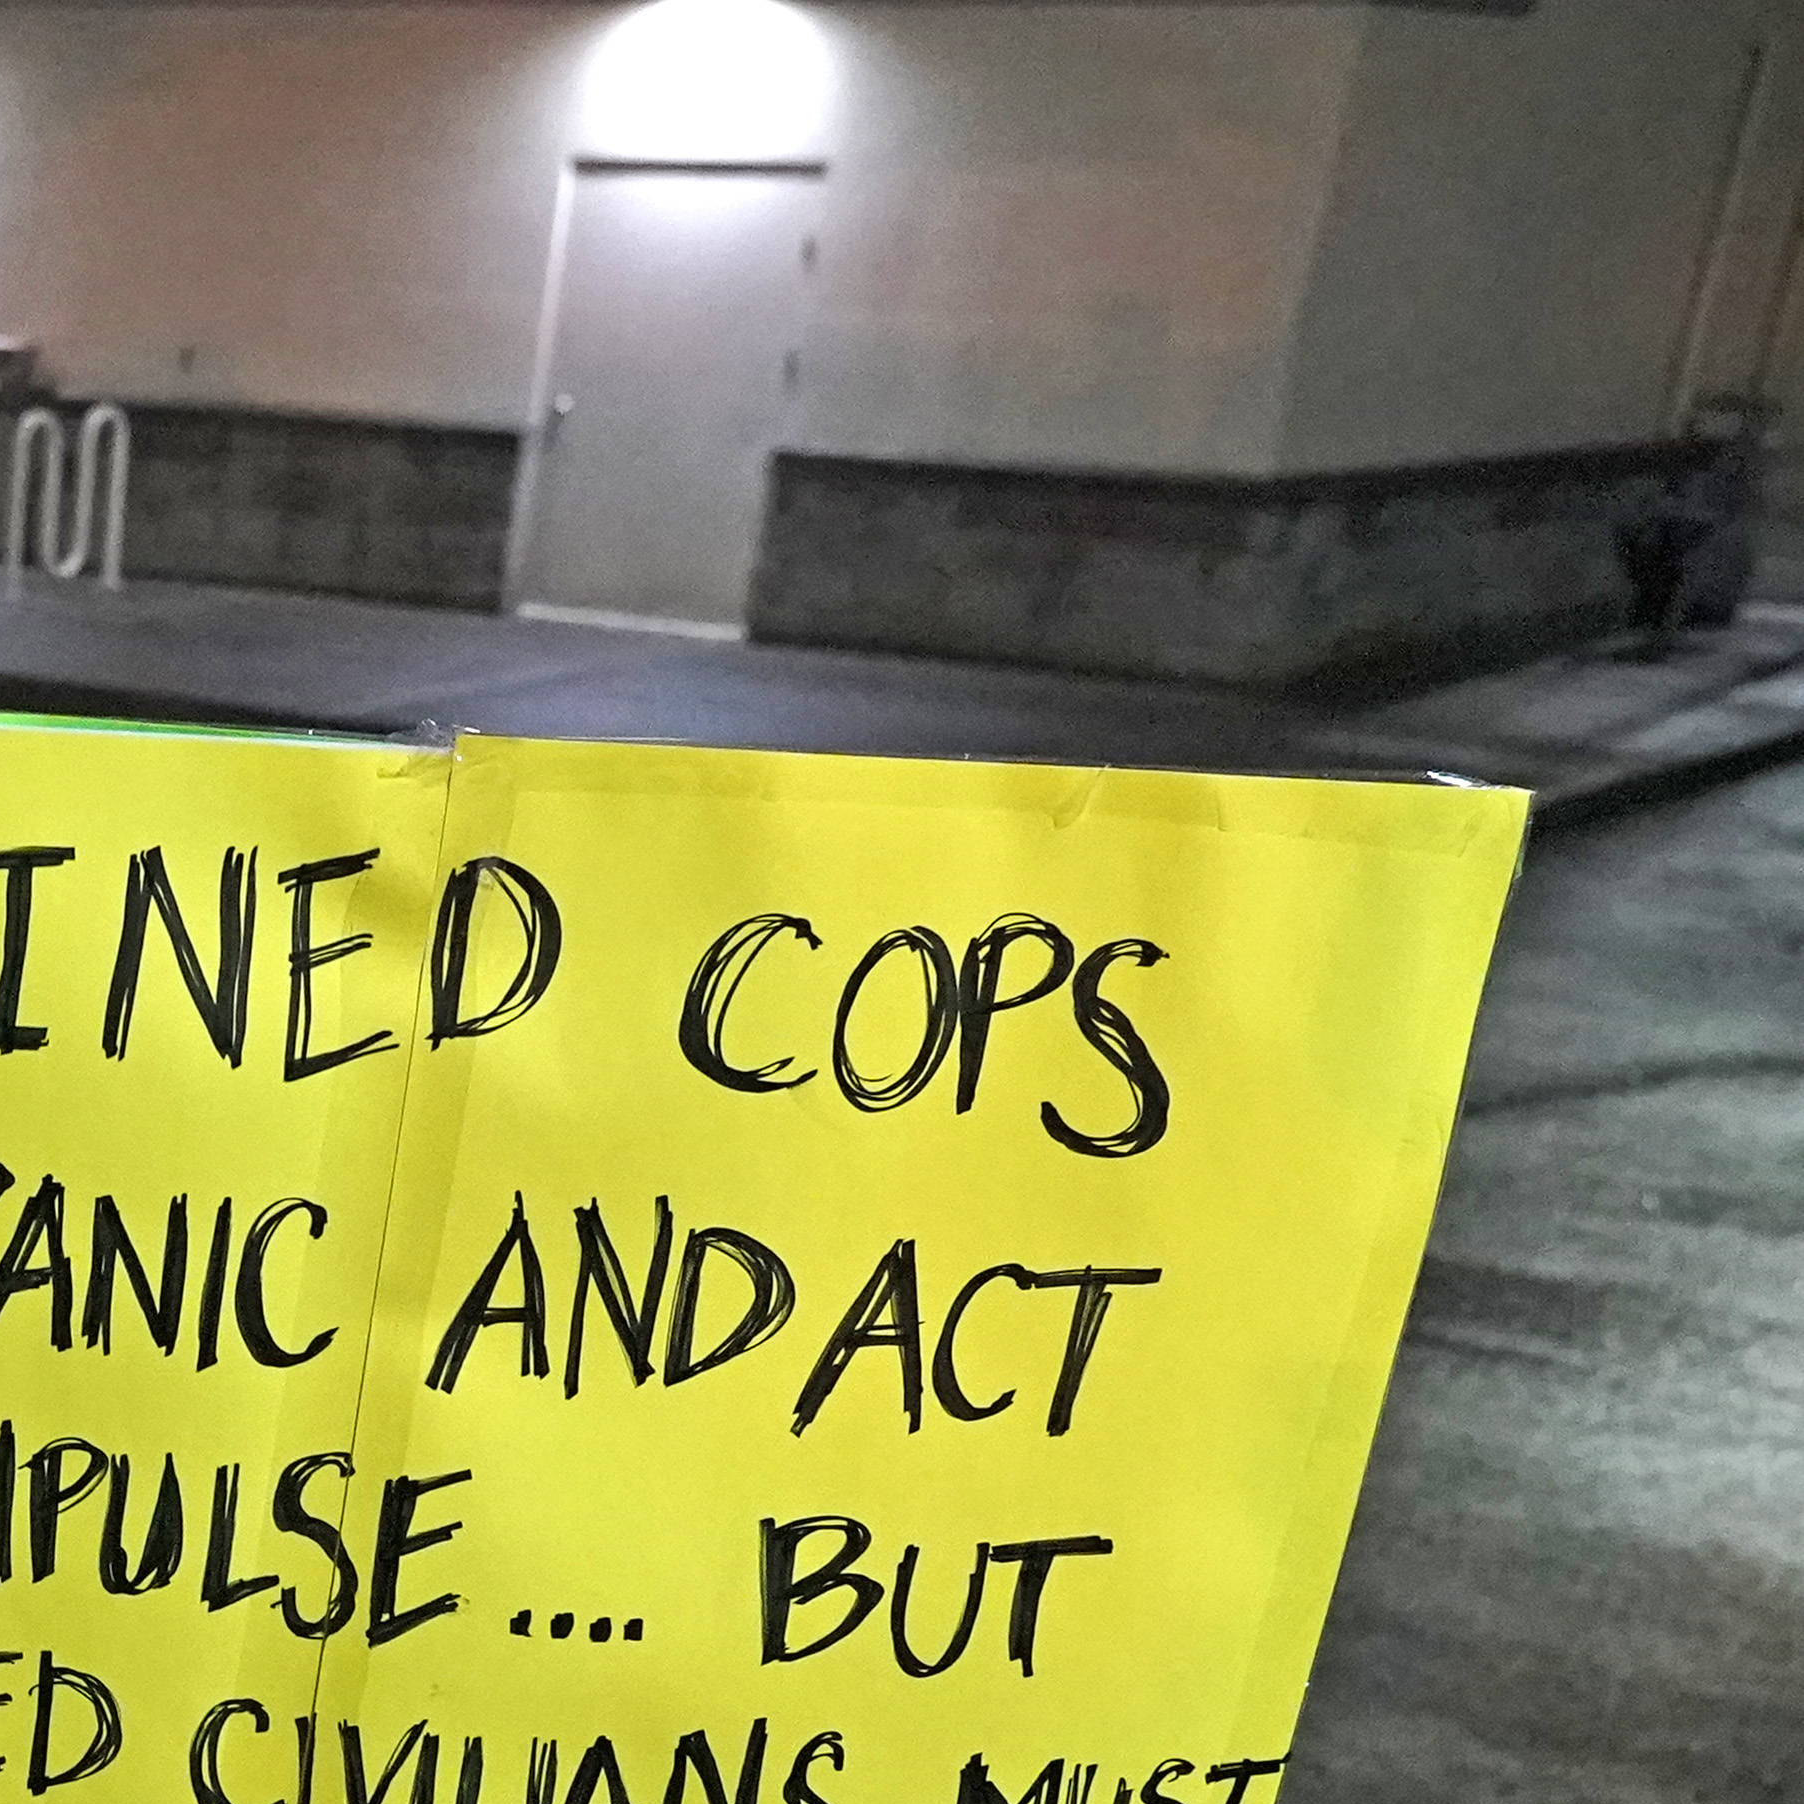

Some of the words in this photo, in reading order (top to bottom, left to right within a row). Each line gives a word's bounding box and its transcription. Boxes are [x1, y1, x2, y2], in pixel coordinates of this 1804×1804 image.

[679, 913, 1169, 1158] COPS
[425, 1190, 795, 1399] AND
[789, 1239, 1162, 1437] ACT
[760, 1516, 1113, 1678] BUT
